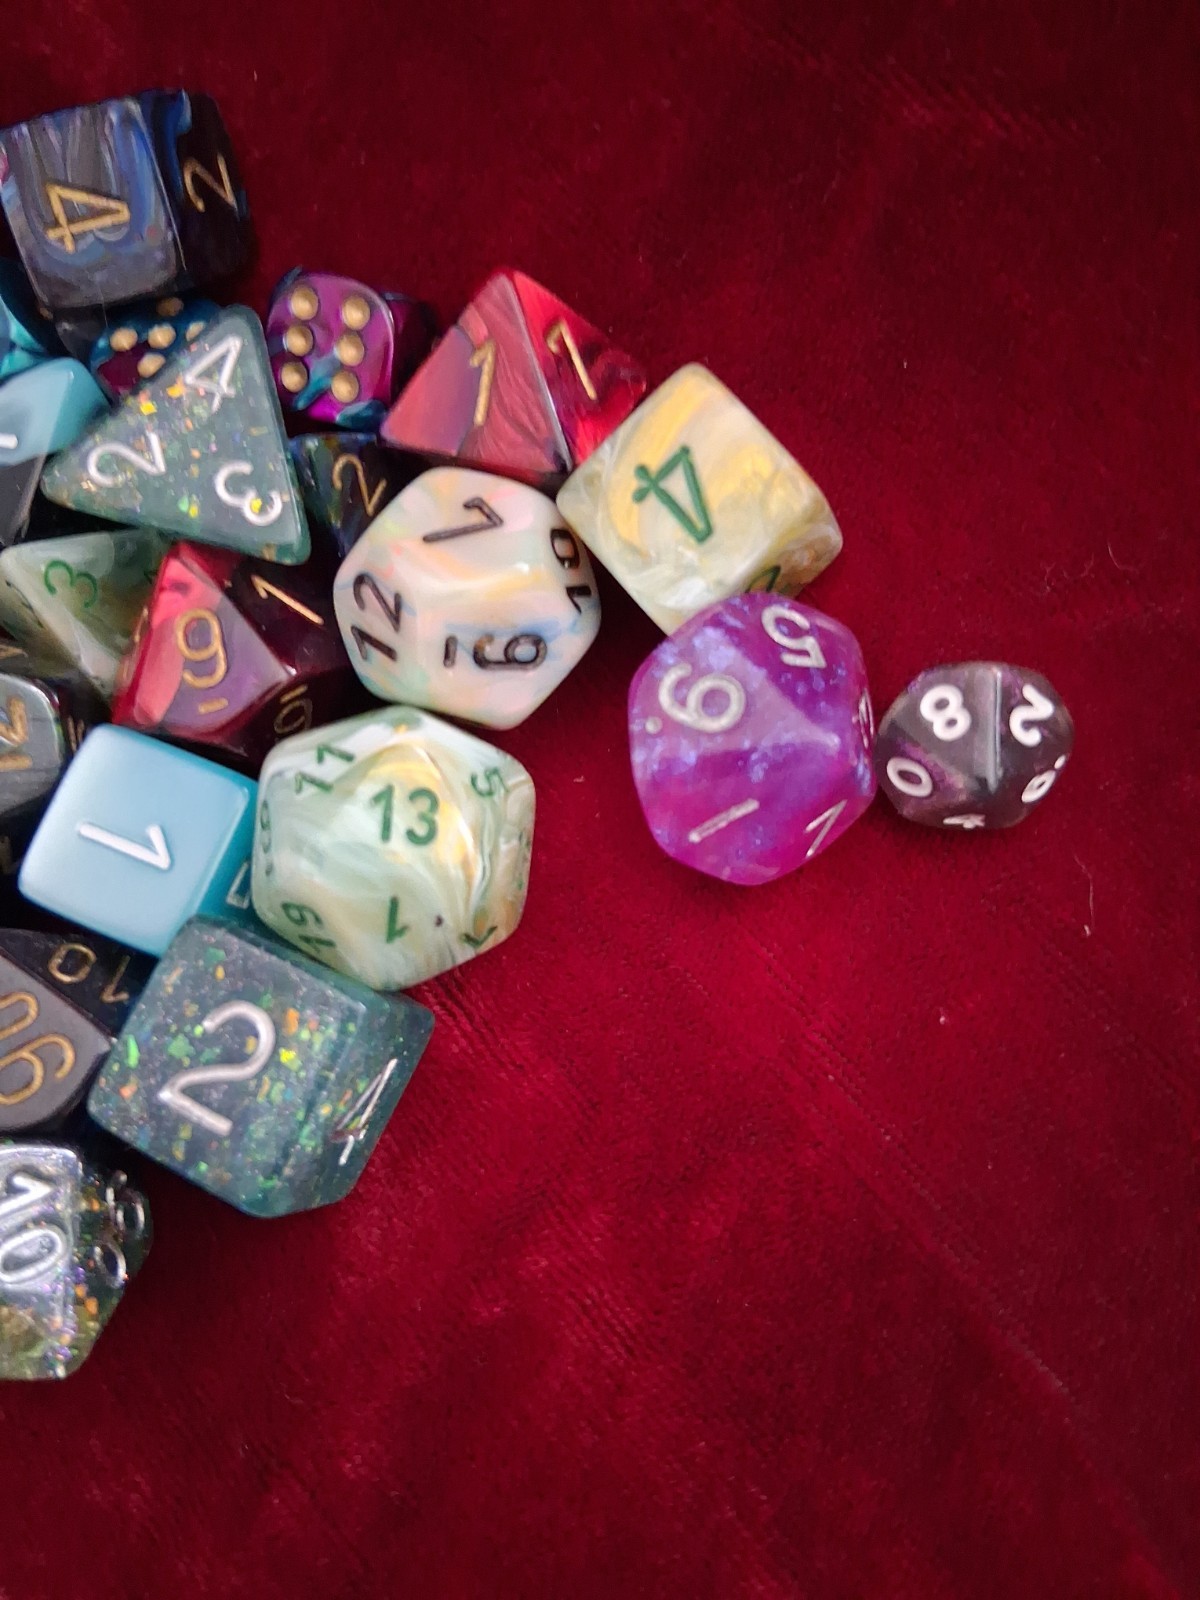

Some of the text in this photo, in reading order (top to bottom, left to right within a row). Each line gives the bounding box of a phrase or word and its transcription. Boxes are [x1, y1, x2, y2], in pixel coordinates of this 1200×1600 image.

[183, 152, 239, 213] 2
[46, 181, 131, 254] 4
[184, 334, 243, 414] 4
[86, 429, 166, 487] 2
[332, 454, 387, 517] 2
[214, 460, 284, 526] 3
[631, 445, 713, 543] 4
[44, 560, 98, 609] 3
[351, 573, 401, 661] 12
[761, 604, 827, 668] 5
[919, 684, 972, 742] 8
[1009, 683, 1055, 747] 2
[370, 784, 440, 846] 13
[156, 999, 276, 1137] 2
